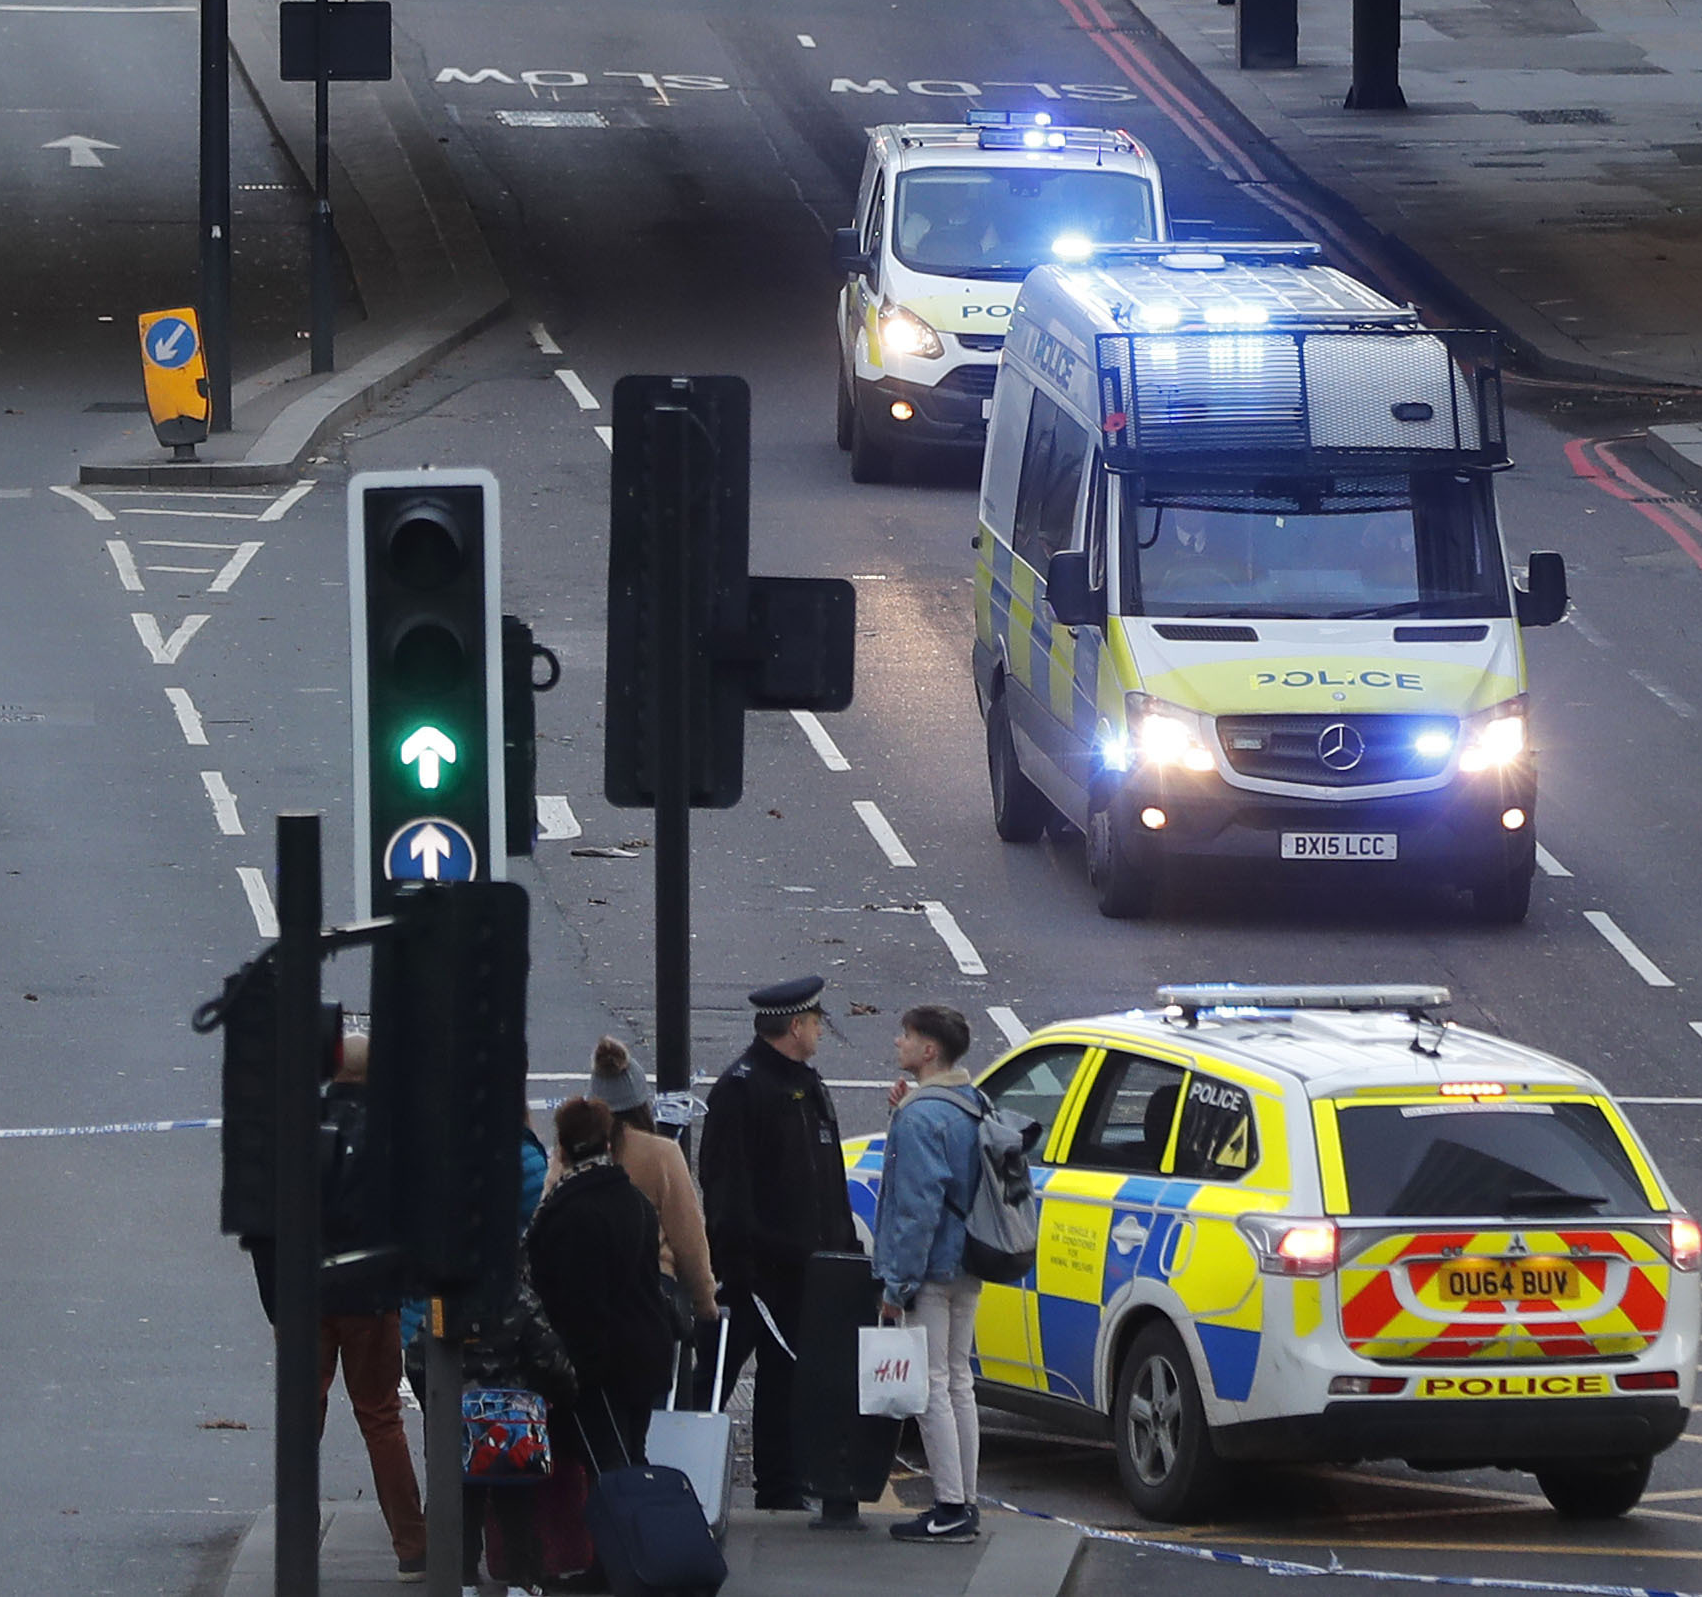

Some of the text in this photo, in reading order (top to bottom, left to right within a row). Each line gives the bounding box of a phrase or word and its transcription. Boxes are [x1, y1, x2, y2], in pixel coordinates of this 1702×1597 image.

[434, 66, 730, 92] SLOW
[830, 77, 1139, 103] SLOW
[1034, 330, 1076, 391] POLICE
[1295, 837, 1385, 855] BX15 LCC
[1188, 1083, 1244, 1112] POLICE
[1450, 1271, 1569, 1295] OU64 BUV
[1426, 1376, 1603, 1396] POLICE
